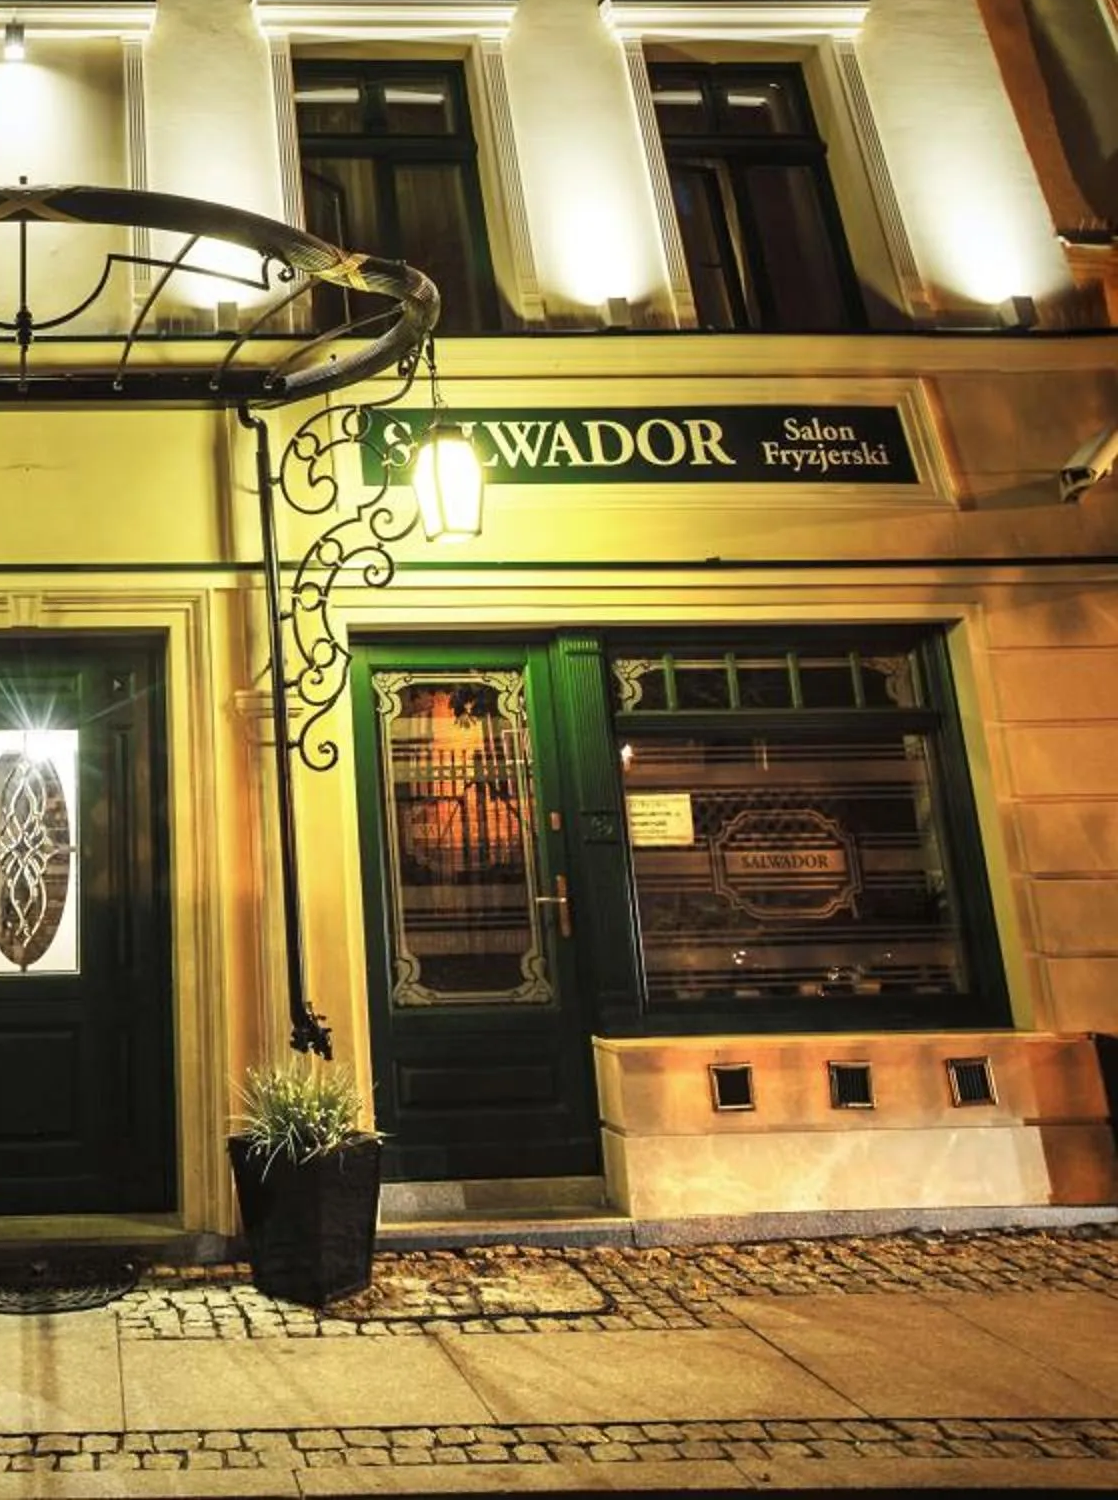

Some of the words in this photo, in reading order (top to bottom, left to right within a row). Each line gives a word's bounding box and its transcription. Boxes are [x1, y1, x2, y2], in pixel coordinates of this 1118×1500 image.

[783, 417, 856, 441] Salon
[761, 441, 890, 473] Fryzjerski
[741, 853, 829, 870] SALWADOR
